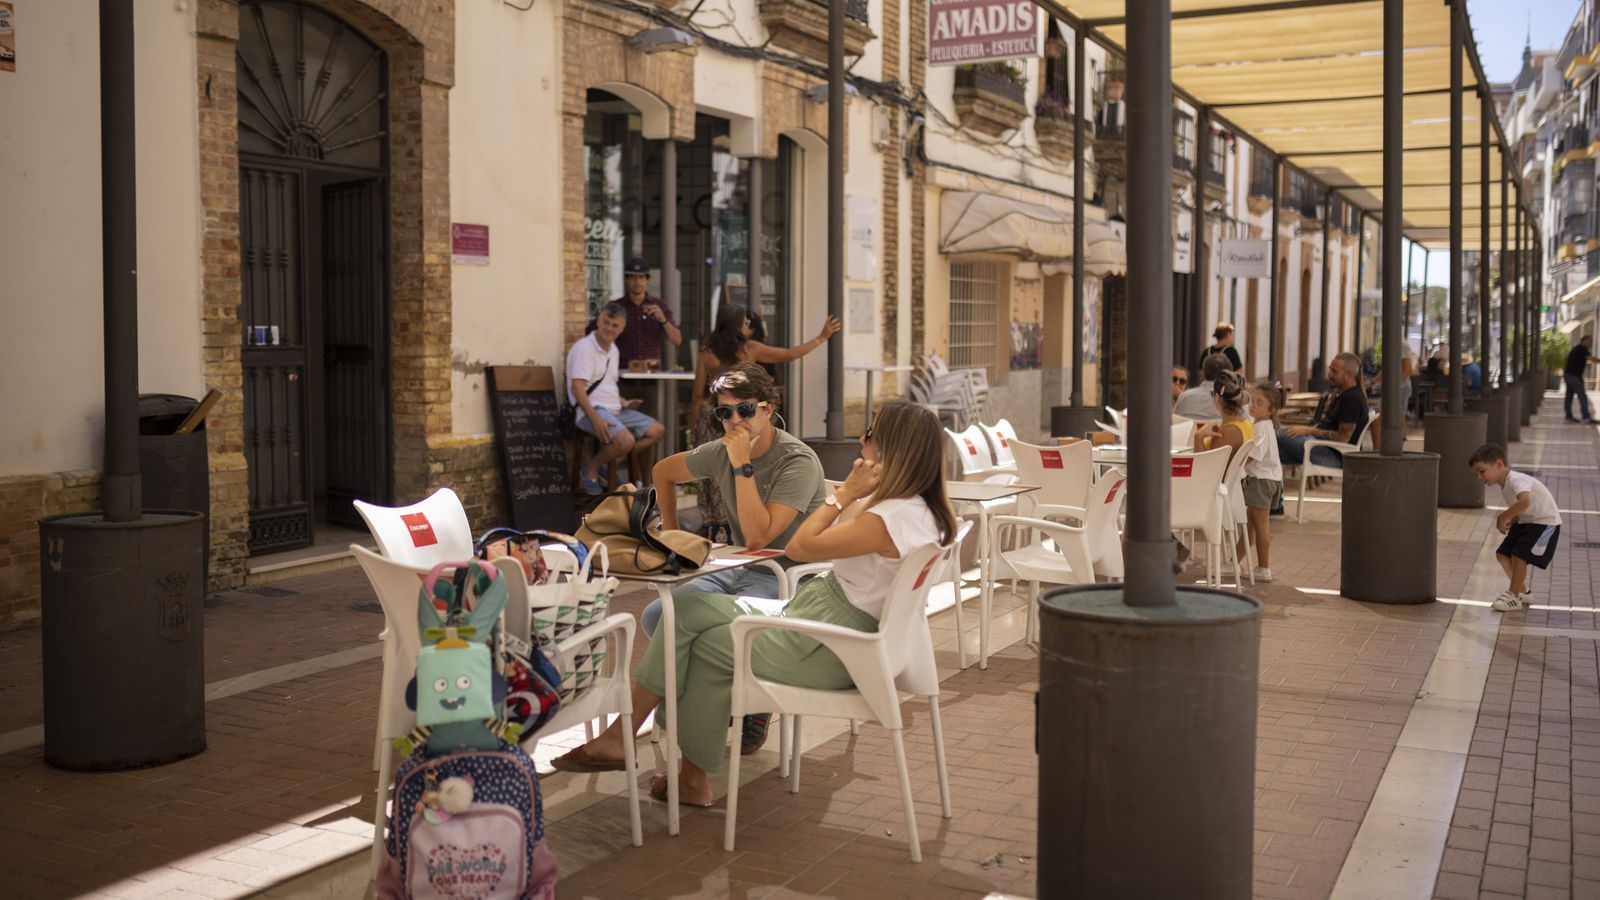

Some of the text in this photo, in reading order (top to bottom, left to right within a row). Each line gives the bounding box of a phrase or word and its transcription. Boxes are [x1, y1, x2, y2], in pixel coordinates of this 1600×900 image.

[932, 1, 1034, 40] AMADIS
[931, 43, 985, 60] PELUQUERIA
[459, 860, 507, 875] WORLD
